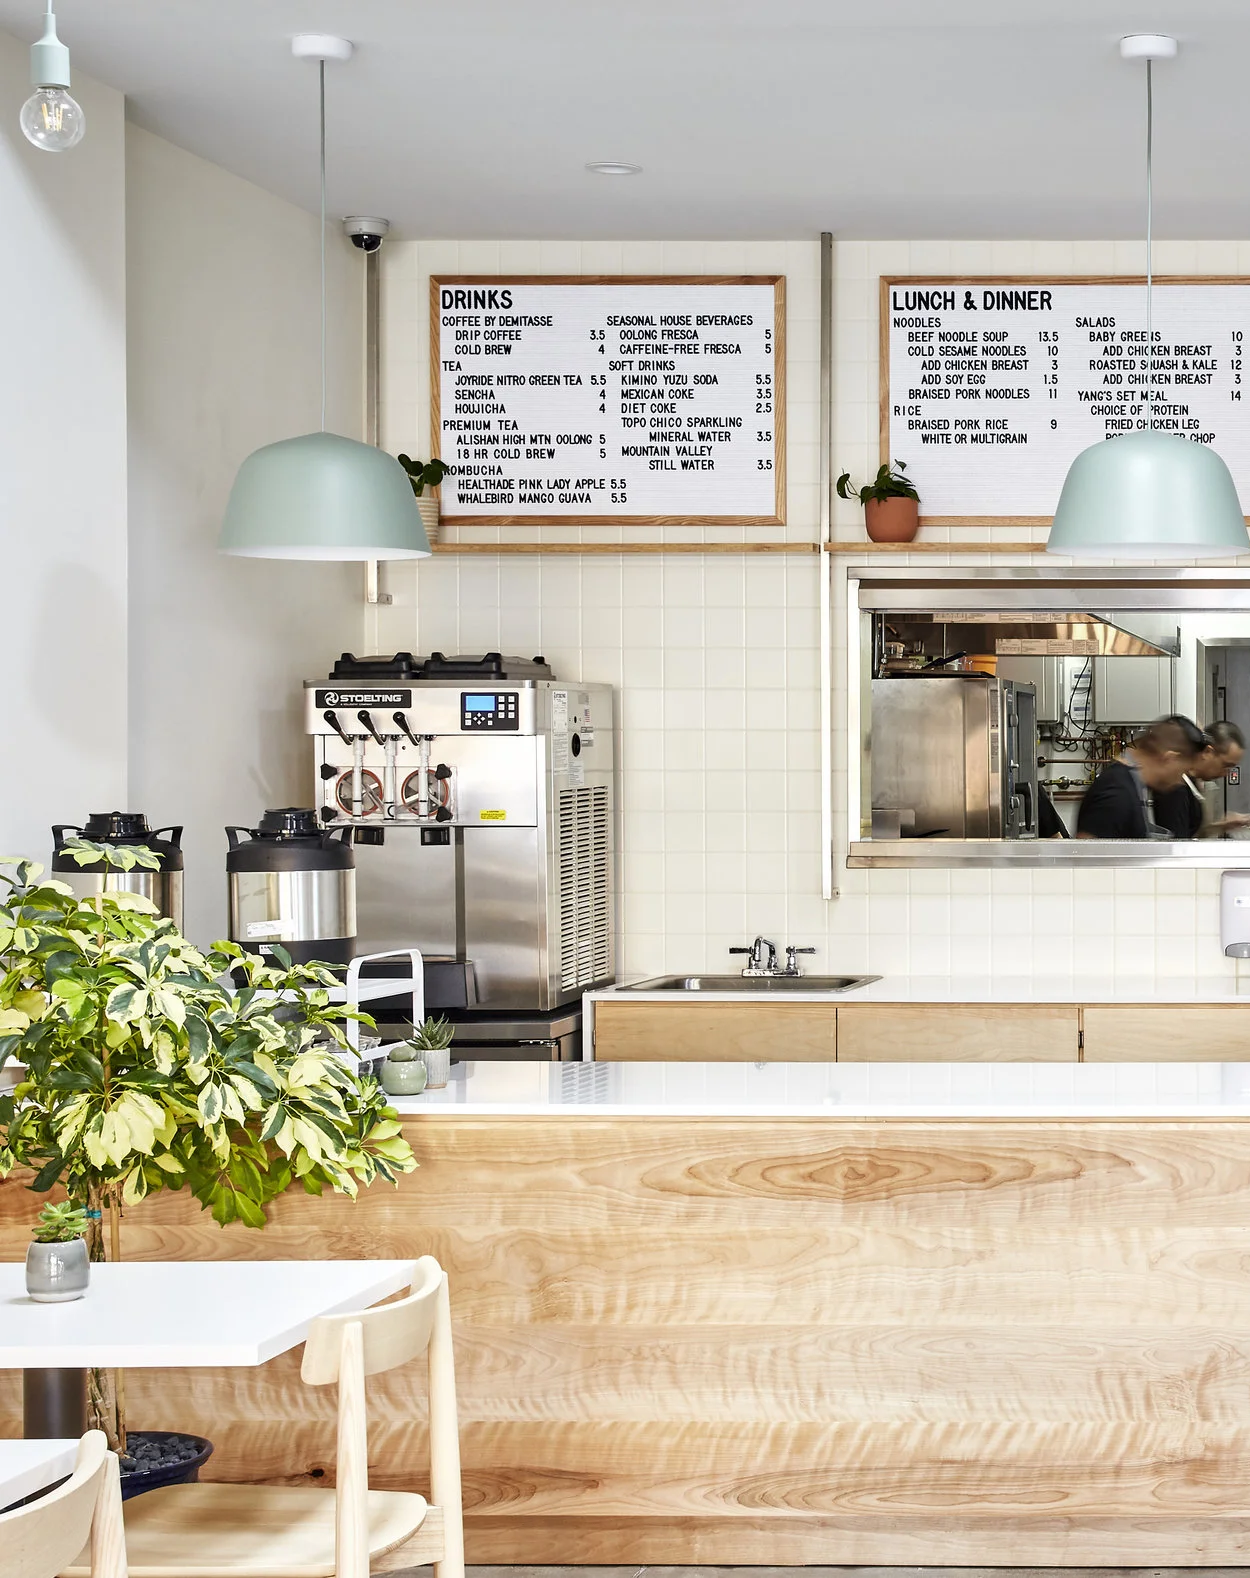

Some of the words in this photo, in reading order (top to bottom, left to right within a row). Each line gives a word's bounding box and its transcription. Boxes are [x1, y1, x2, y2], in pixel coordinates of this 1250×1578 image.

[441, 289, 513, 310] DRINKS
[892, 290, 955, 311] LUNCH
[963, 290, 978, 311] &
[983, 290, 1052, 311] DINNER
[441, 315, 481, 327] COFFEE
[484, 315, 497, 327] BY
[498, 315, 553, 327] DEMITASSE
[606, 315, 657, 327] SEASONAL
[659, 315, 693, 326] HOUSE
[696, 314, 754, 326] BEVERAGES
[893, 317, 942, 328] NOODLES
[1075, 316, 1116, 328] SALADS
[455, 329, 481, 341] DRIP
[483, 329, 522, 341] COFFEE
[589, 329, 606, 341] 3.5
[619, 329, 658, 341] OOLONG
[661, 329, 699, 340] FRESCA
[908, 331, 935, 343] BEEF
[938, 331, 978, 343] NOODLE
[982, 331, 1009, 343] SOUP
[1038, 331, 1059, 343] 13.5
[454, 344, 482, 356] COLD
[484, 344, 512, 356] BREW
[619, 343, 700, 355] CAFFEINE-FREE
[703, 343, 742, 355] FRESCA
[907, 345, 935, 357] COLD
[938, 345, 978, 357] SESAME
[981, 345, 1027, 357] NOODLES
[1047, 345, 1059, 357] 10
[441, 360, 462, 372] TEA
[608, 360, 635, 372] SOFT
[638, 360, 676, 371] DRINKS
[454, 374, 494, 386] JOYRIDE
[496, 374, 526, 386] NITRO
[528, 374, 561, 386] GREEN
[562, 374, 583, 386] TEA
[590, 374, 607, 386] 5.5
[621, 374, 658, 386] KIMINO
[662, 374, 688, 386] YUZU
[692, 374, 719, 385] SODA
[755, 374, 772, 385] 5.5
[454, 389, 496, 400] SENCHA
[621, 388, 665, 400] MEXICAN
[668, 388, 695, 400] COKE
[756, 388, 772, 400] 3.5
[908, 388, 951, 400] BRAISED
[955, 388, 981, 400] PORK
[985, 388, 1030, 400] NOODLES
[1048, 388, 1057, 399] 11
[455, 403, 506, 415] HOUJICHA
[893, 405, 922, 416] RICE
[443, 419, 491, 431] PREMIUM
[497, 419, 519, 431] TEA
[620, 416, 647, 428] TOPO
[649, 417, 683, 428] CHICO
[686, 416, 743, 428] SPARKLING
[908, 419, 950, 431] BRAISED
[954, 419, 981, 430] PORK
[985, 419, 1009, 430] RICE
[456, 434, 500, 446] ALISHAN
[502, 434, 526, 445] HIGH
[529, 434, 551, 445] MTN
[555, 434, 593, 445] OOLONG
[649, 431, 694, 443] MINERAL
[697, 431, 731, 442] WATER
[756, 431, 772, 442] 3.5
[921, 433, 952, 445] WHITE
[954, 433, 968, 445] OR
[970, 433, 1028, 444] MULTIGRAIN
[457, 448, 470, 460] 18
[474, 448, 489, 460] HR
[493, 448, 521, 460] COLD
[525, 448, 556, 460] BREW
[621, 445, 670, 457] MOUNTAIN
[675, 445, 713, 457] VALLEY
[458, 478, 515, 490] HEALTHADE
[518, 478, 544, 490] PINK
[546, 478, 571, 490] LADY
[574, 478, 606, 490] APPLE
[610, 478, 627, 490] 5.5
[457, 492, 514, 504] WHALEBIRD
[518, 492, 555, 504] MANGO
[558, 492, 592, 504] GUAVA
[611, 492, 627, 504] 5.5
[340, 694, 402, 702] STOELTING
